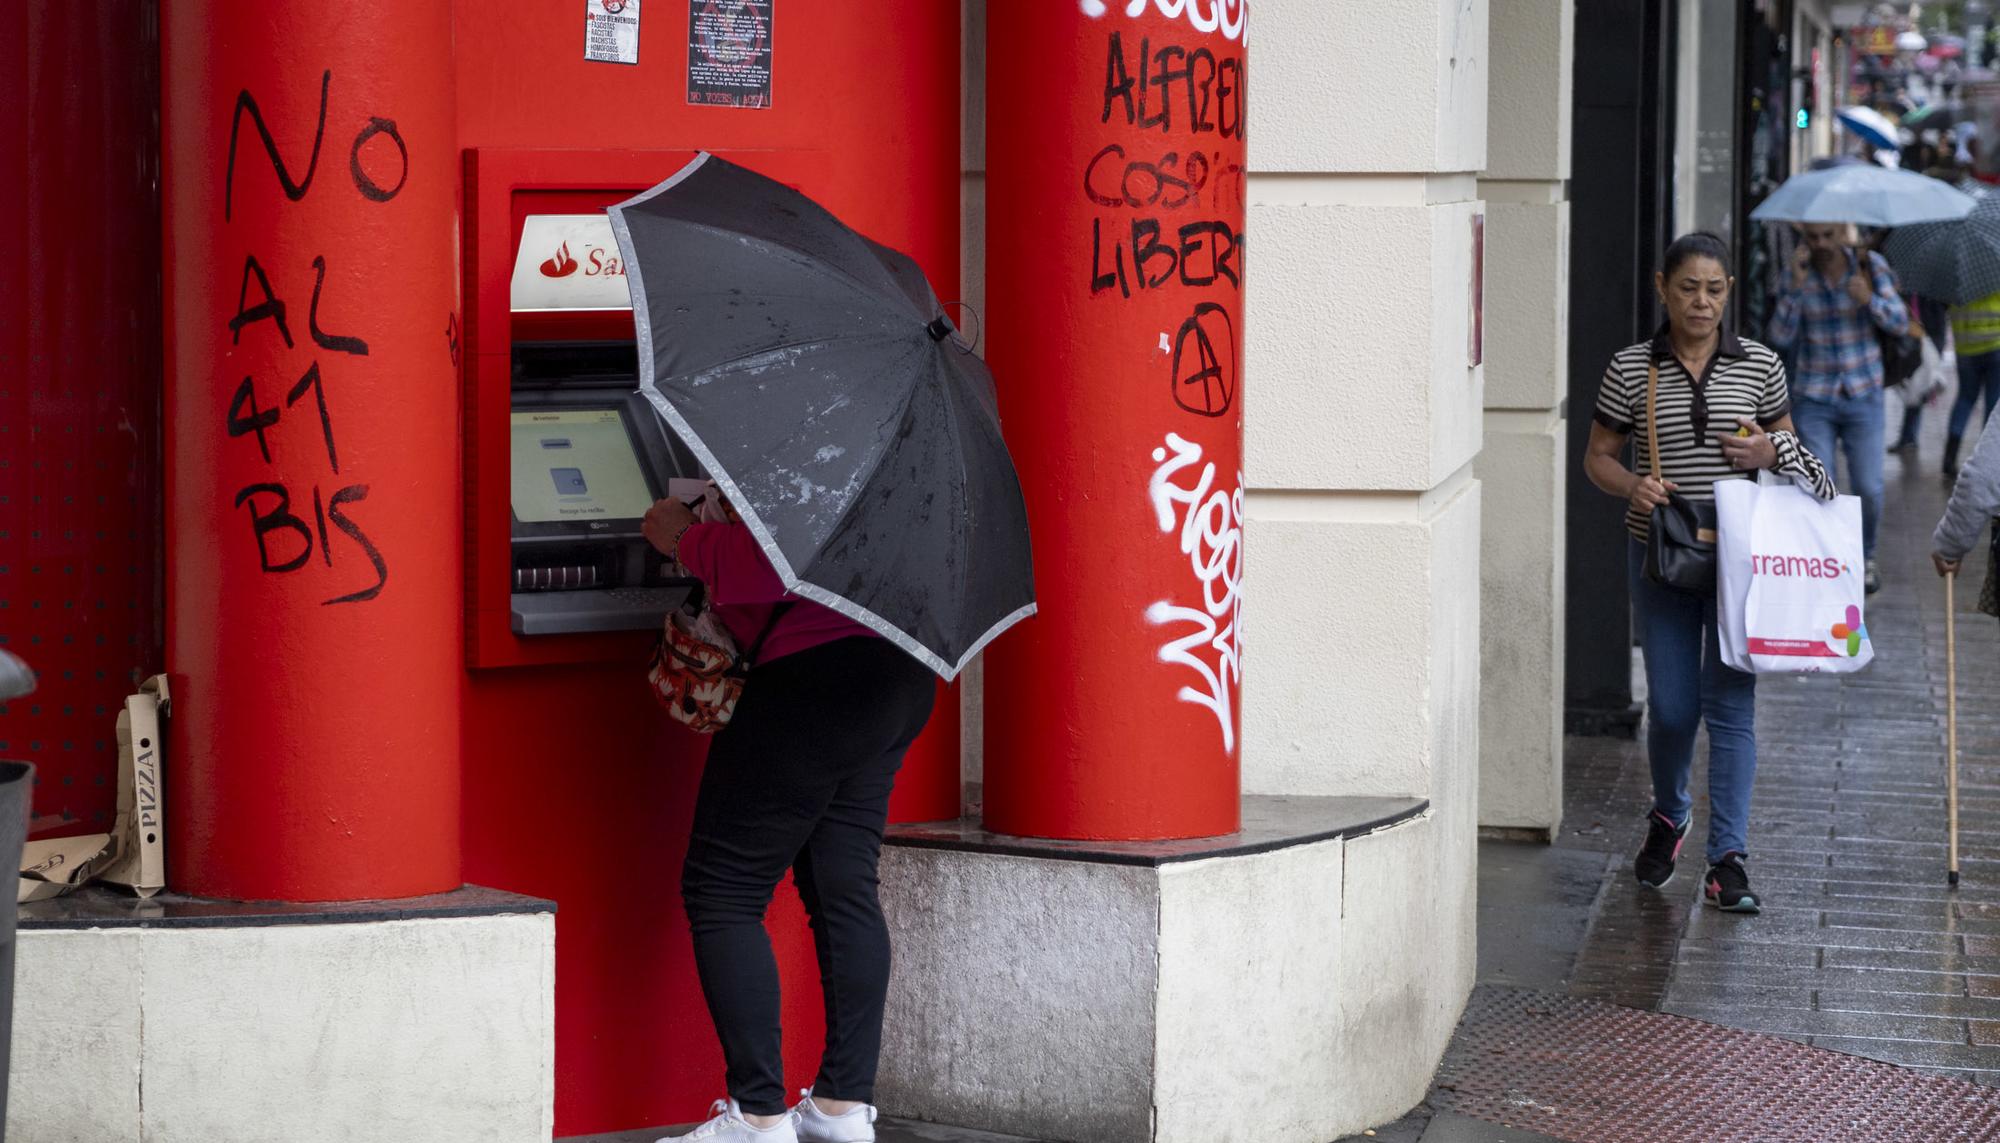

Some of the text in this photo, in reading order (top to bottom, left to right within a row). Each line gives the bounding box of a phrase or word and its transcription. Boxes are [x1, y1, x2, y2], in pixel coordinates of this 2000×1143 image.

[591, 37, 617, 45] MACHISTAS
[225, 69, 408, 223] NO
[229, 255, 369, 356] AL
[585, 248, 625, 276] Sa
[228, 360, 339, 475] 41
[236, 484, 387, 606] BIS
[137, 751, 157, 828] PIZZA
